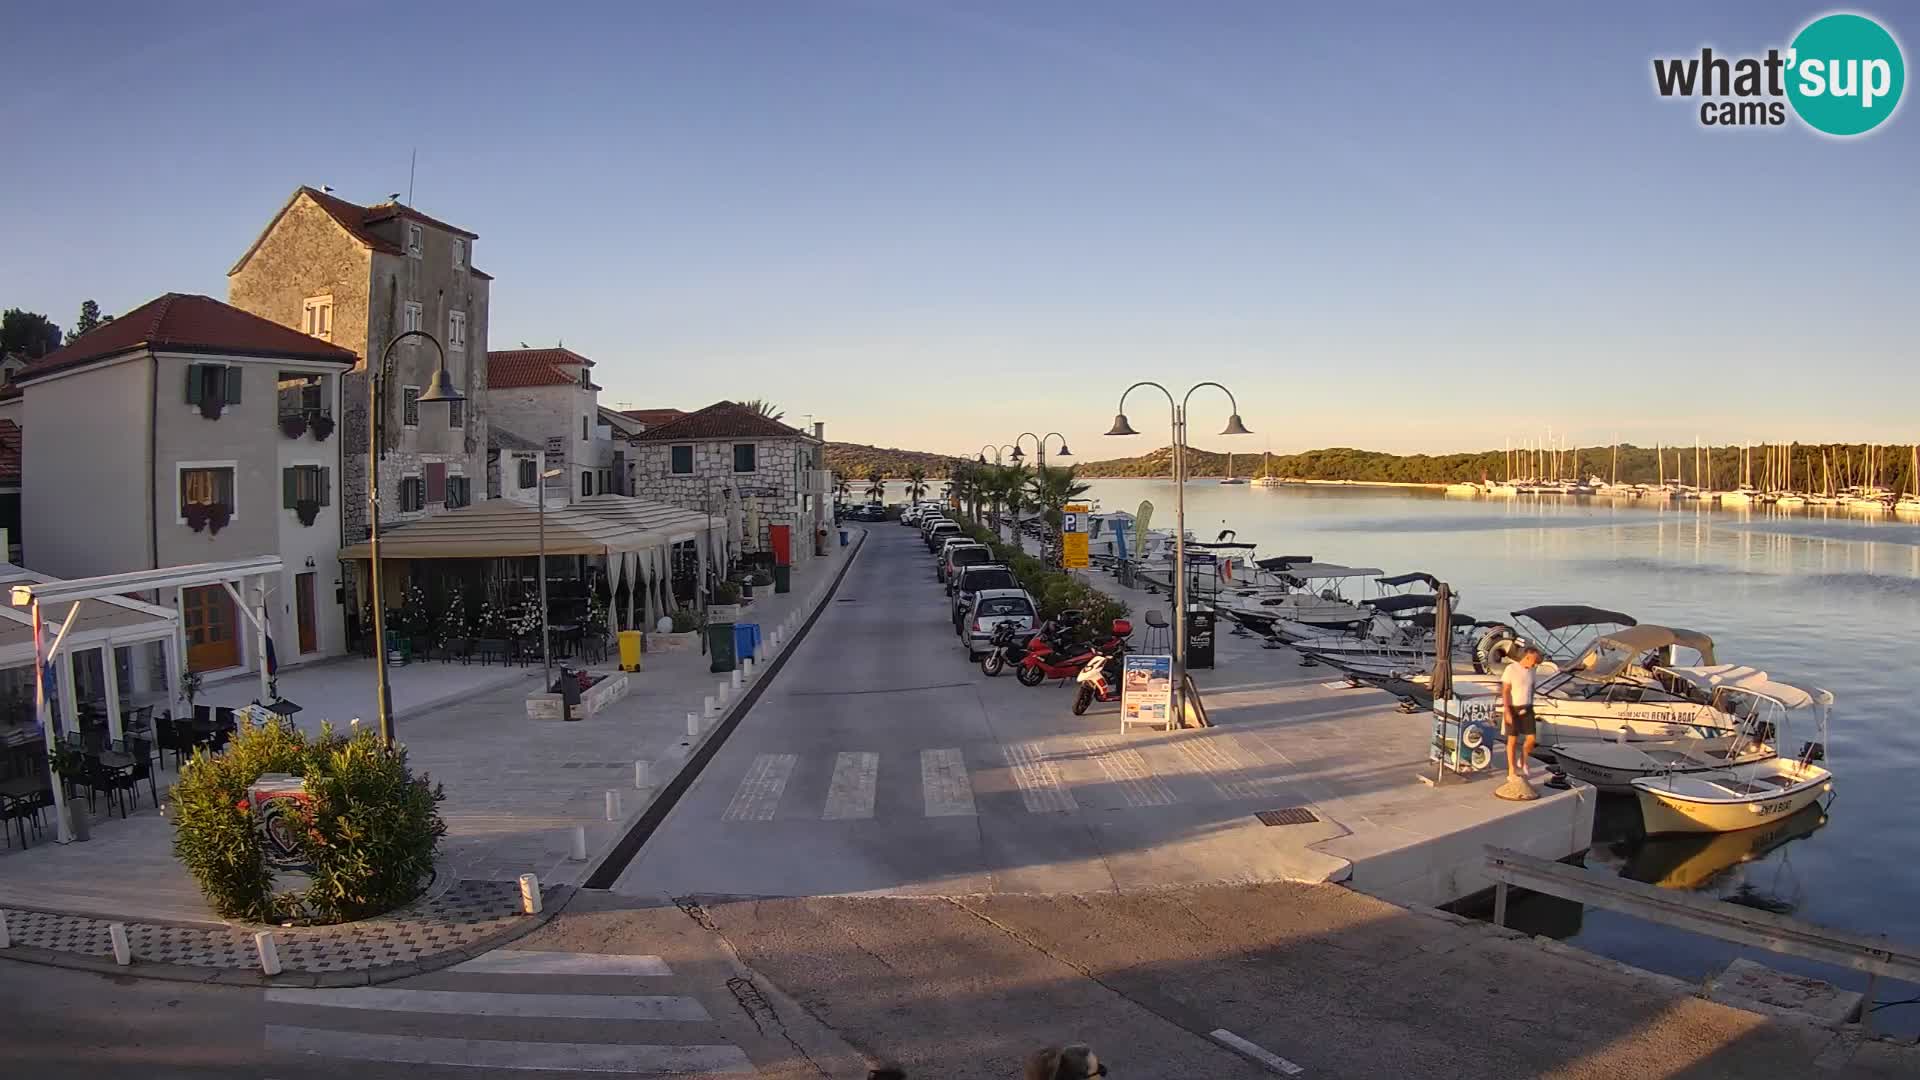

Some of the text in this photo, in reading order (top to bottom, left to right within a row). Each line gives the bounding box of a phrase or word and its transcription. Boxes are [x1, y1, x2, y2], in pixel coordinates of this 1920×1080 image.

[1463, 703, 1494, 713] RENT
[1463, 711, 1494, 721] A BOAT
[1651, 711, 1670, 721] RENT
[1671, 711, 1677, 721] A
[1677, 712, 1697, 723] BOAT
